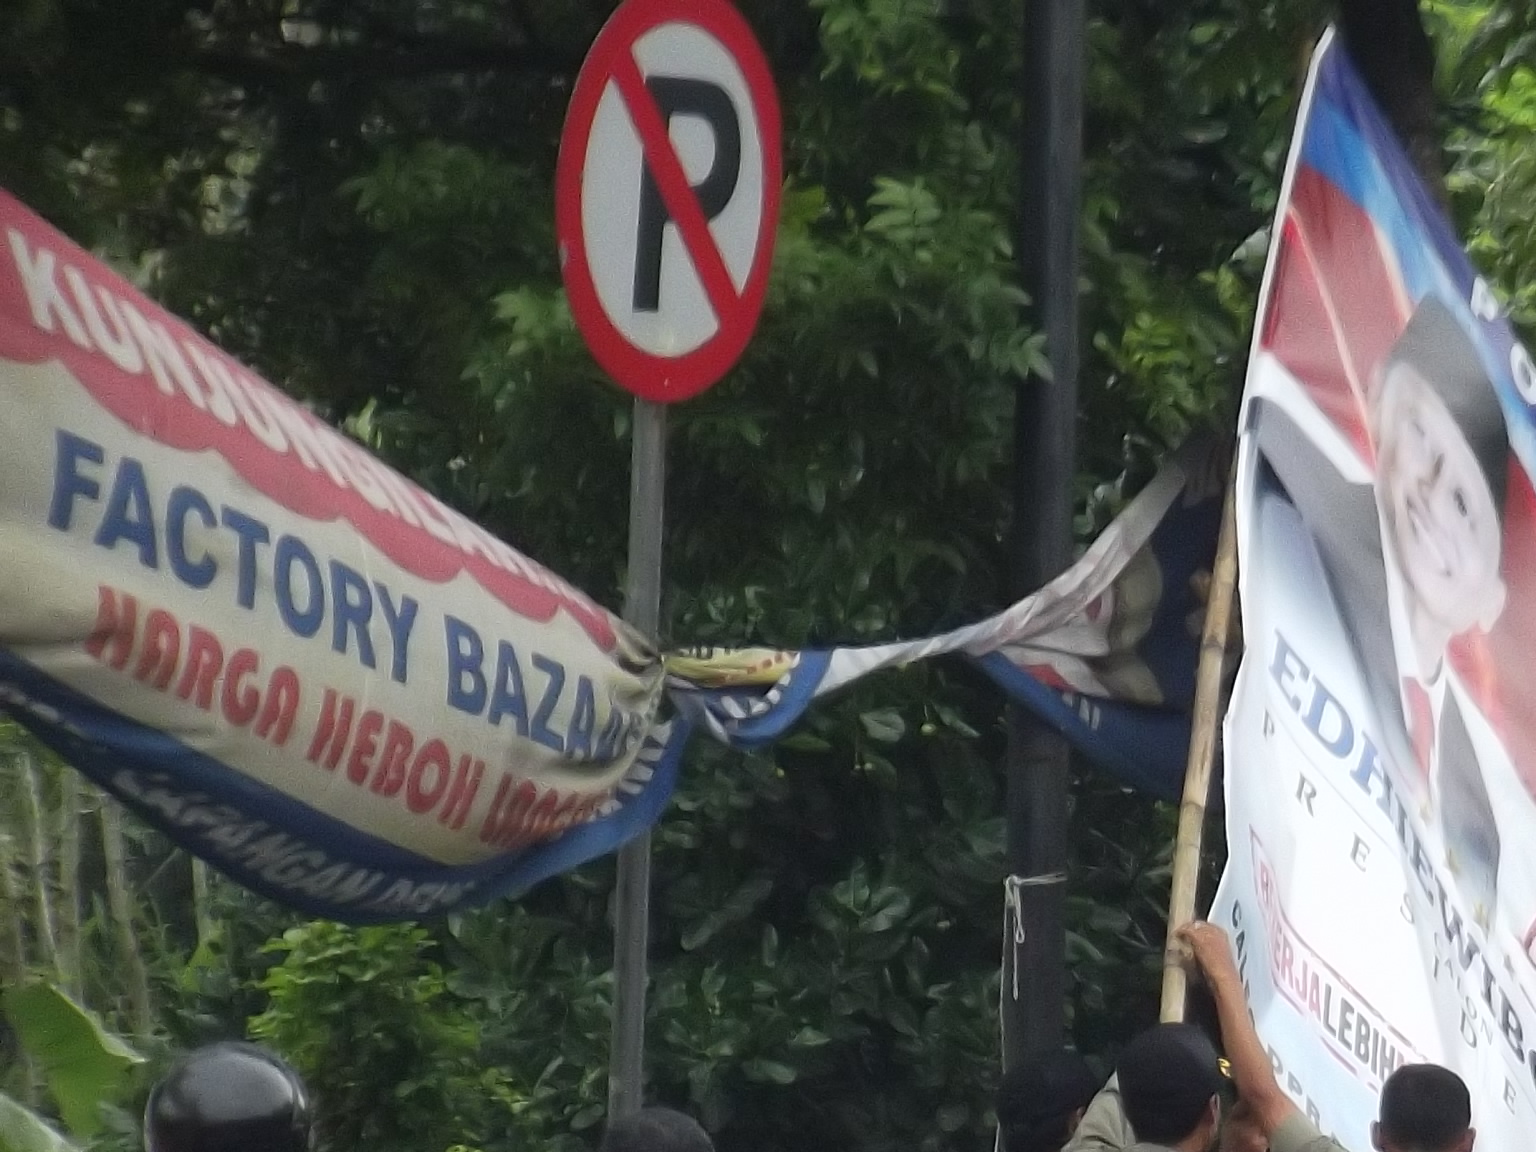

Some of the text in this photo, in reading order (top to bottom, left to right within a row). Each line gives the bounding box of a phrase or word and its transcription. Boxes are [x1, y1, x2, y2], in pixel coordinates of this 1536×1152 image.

[48, 427, 419, 685] FACTORY
[85, 586, 301, 748] HARGA
[306, 687, 486, 831] HEBOH
